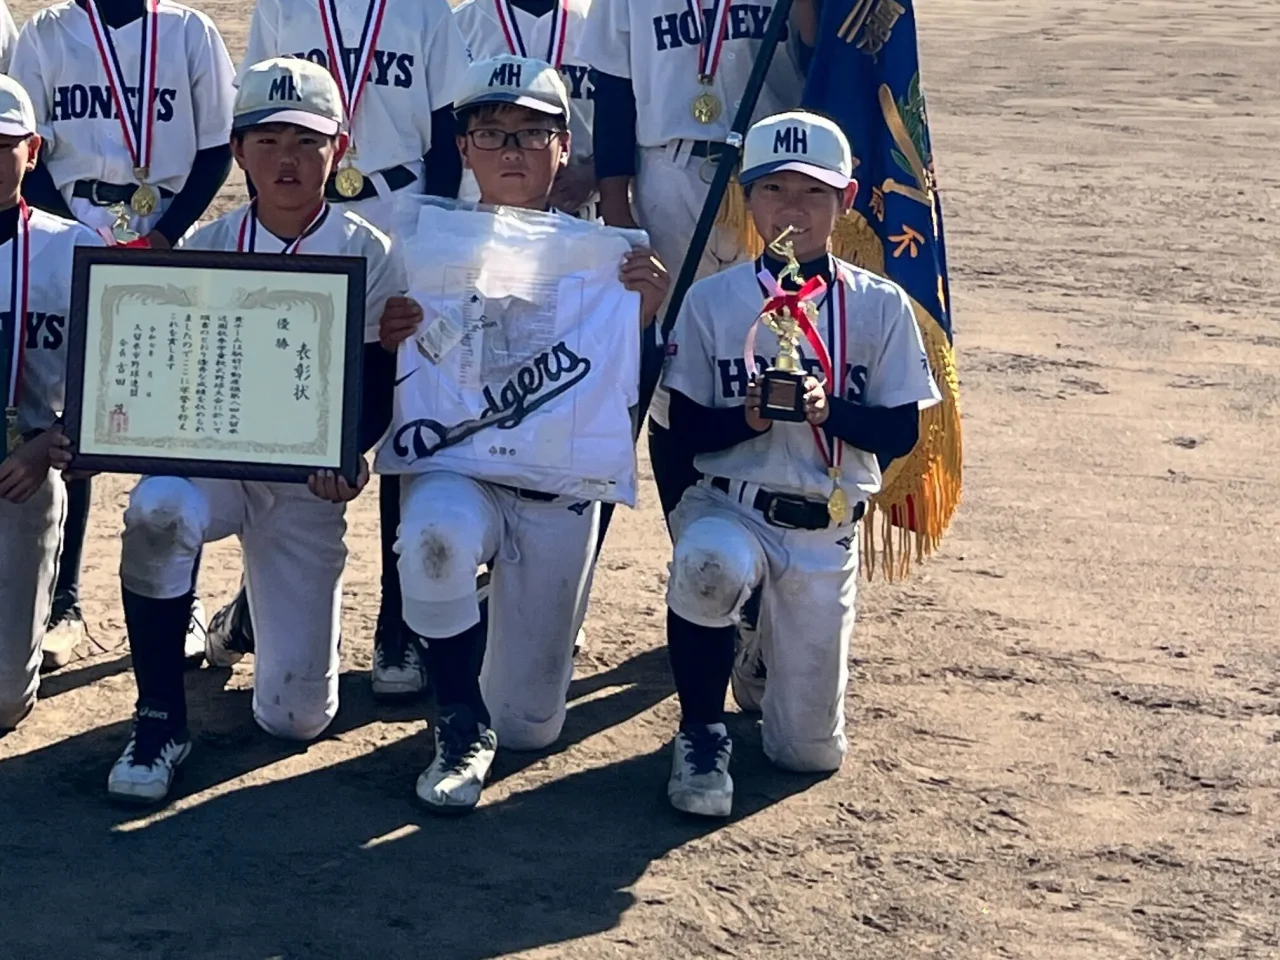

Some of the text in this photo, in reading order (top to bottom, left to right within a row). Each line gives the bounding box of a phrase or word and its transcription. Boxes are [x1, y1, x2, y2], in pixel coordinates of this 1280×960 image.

[488, 63, 521, 87] MH
[773, 127, 808, 154] MH
[393, 341, 592, 466] Ddgers
